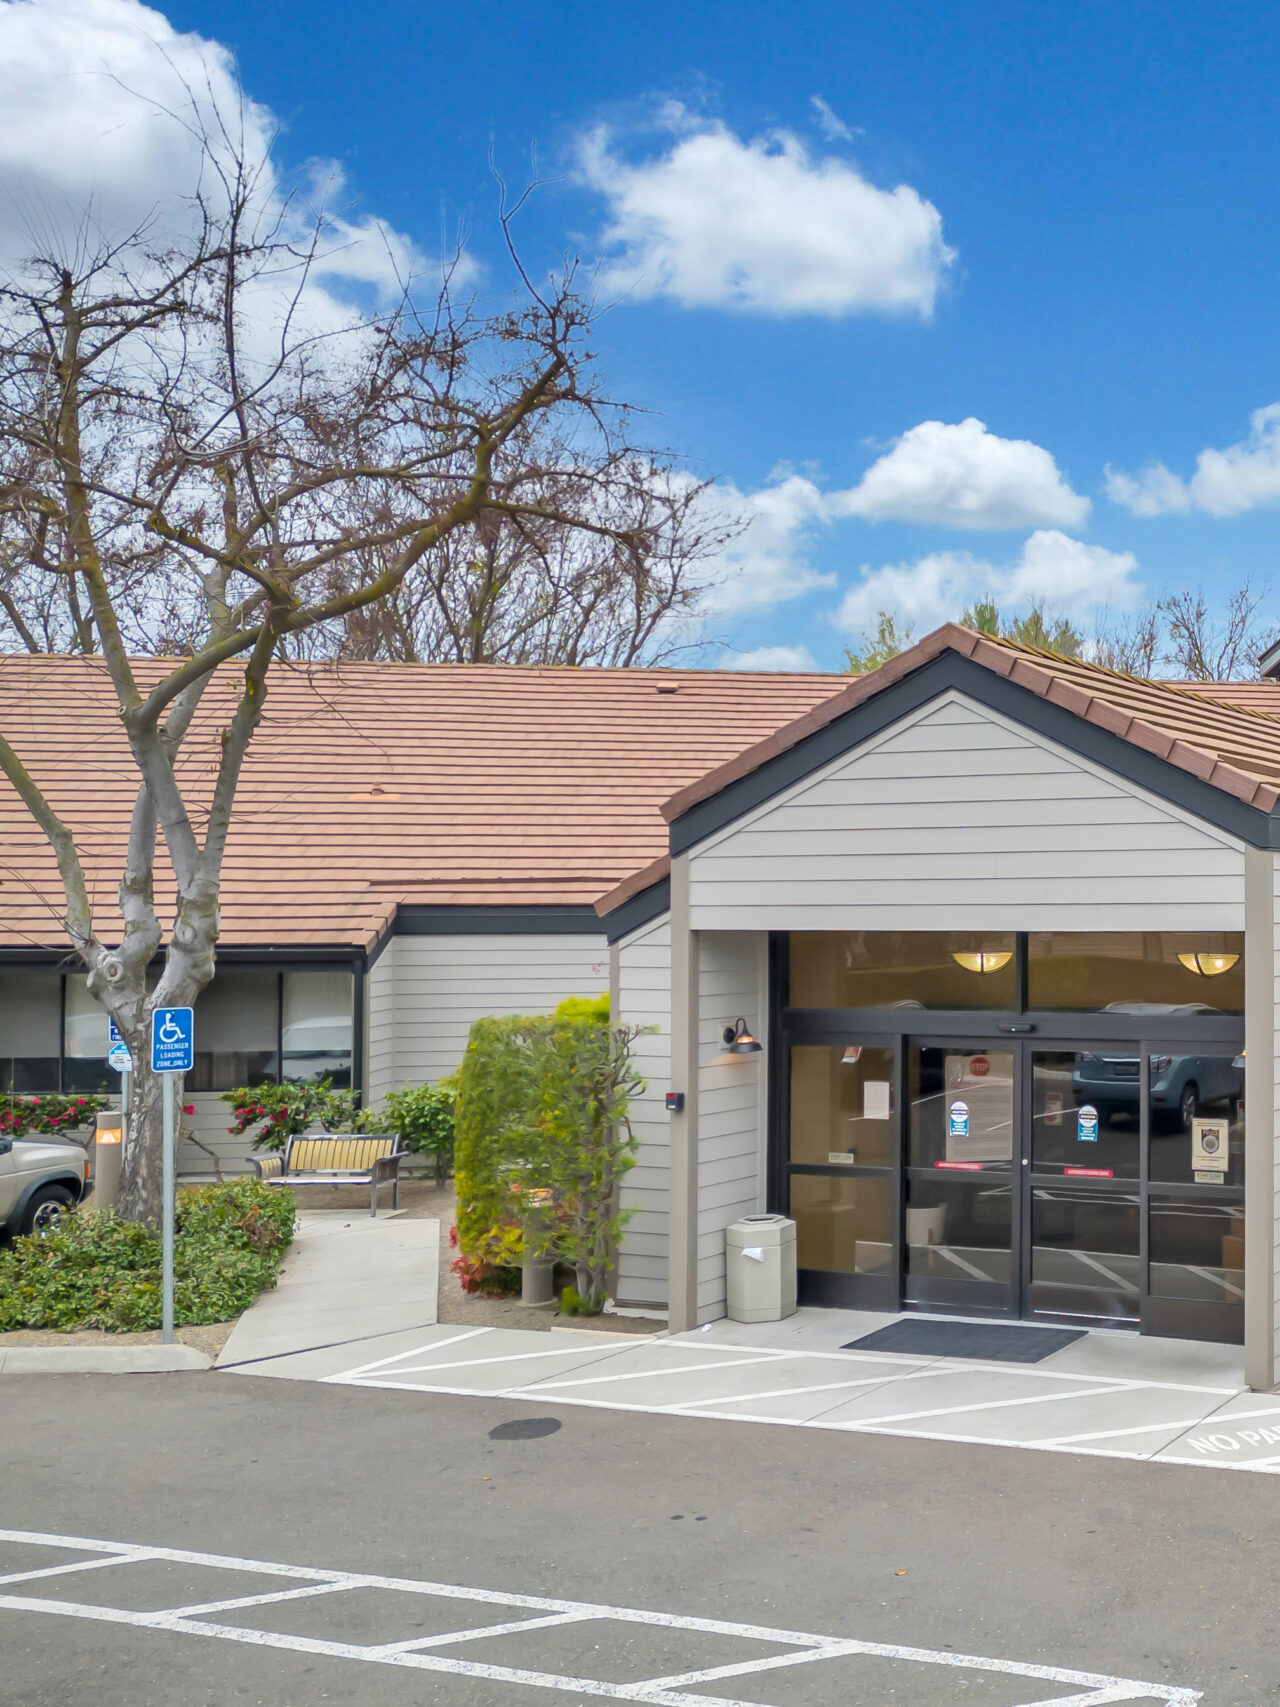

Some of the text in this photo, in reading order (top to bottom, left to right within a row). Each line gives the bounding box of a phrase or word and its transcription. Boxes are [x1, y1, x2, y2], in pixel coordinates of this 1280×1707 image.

[156, 1042, 189, 1050] PASSENGER
[156, 1060, 171, 1068] ZONE
[1185, 1434, 1239, 1454] NO
